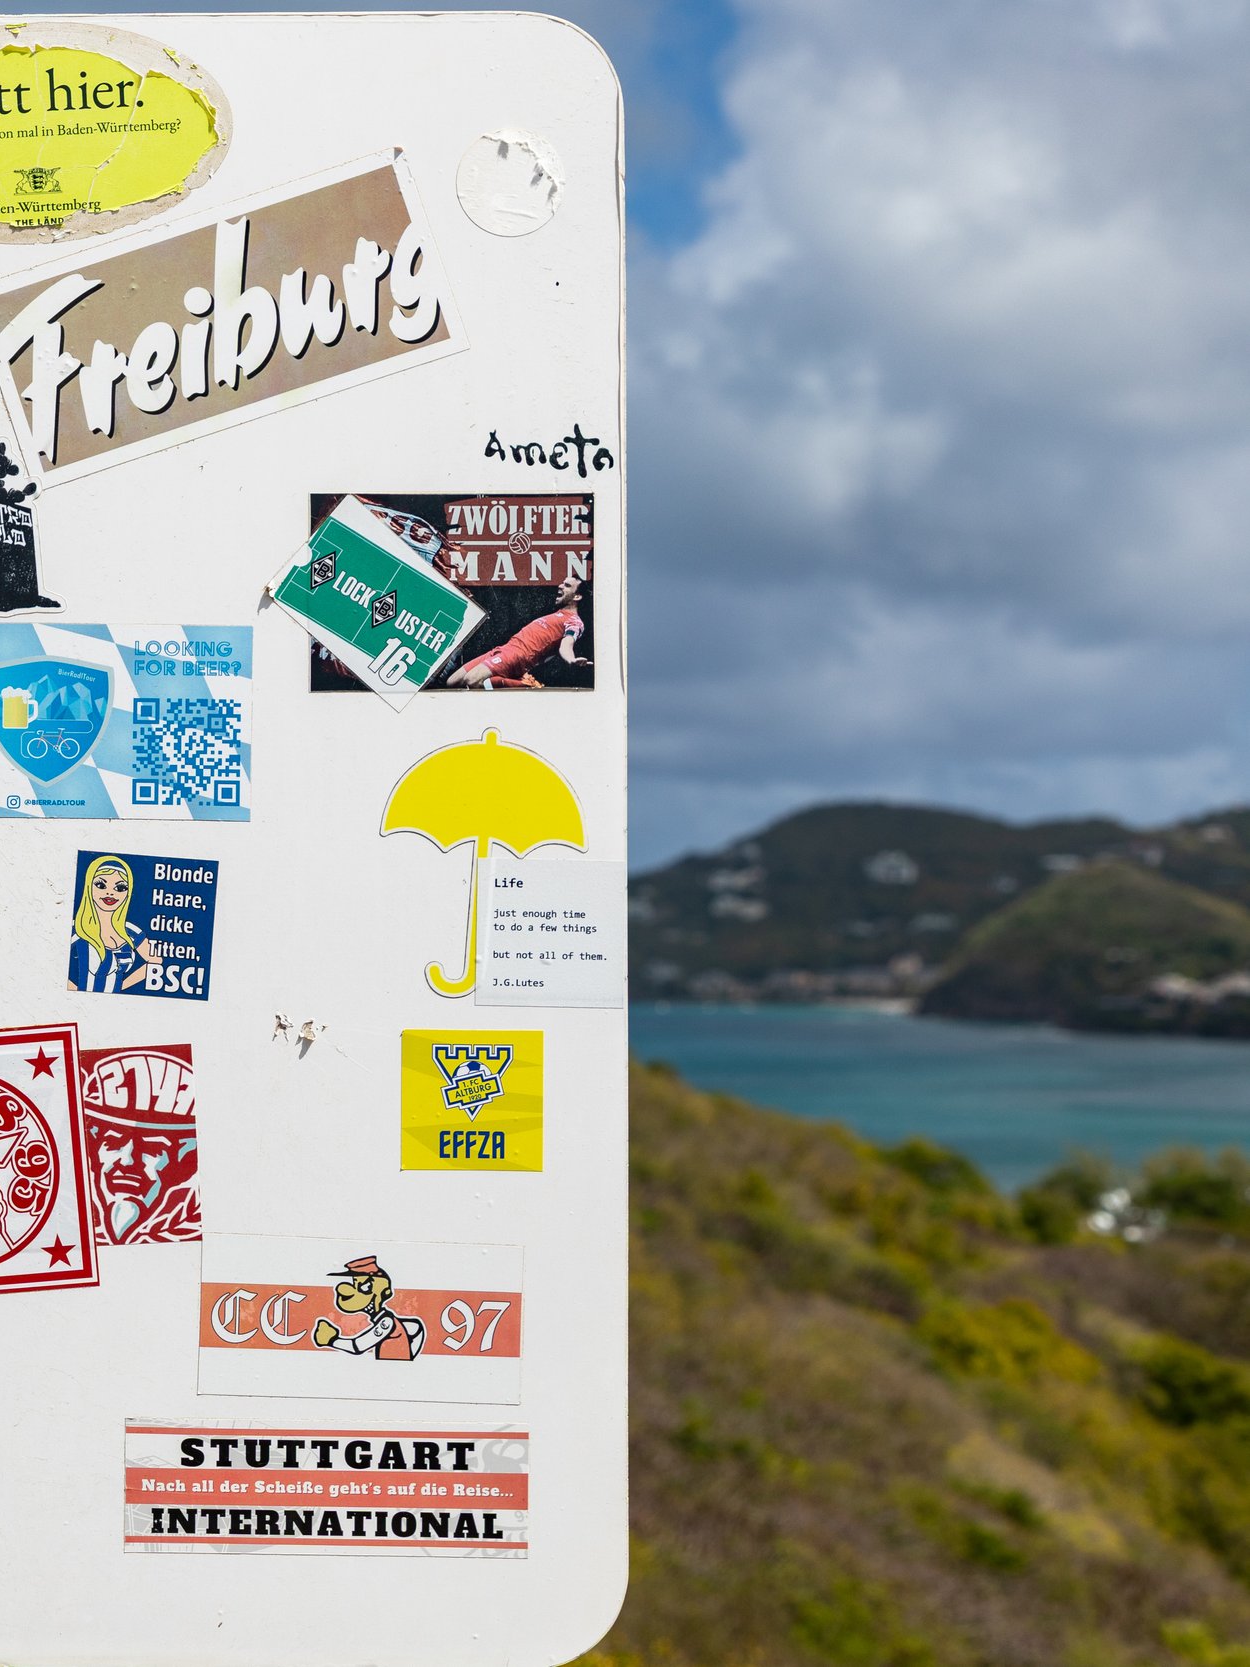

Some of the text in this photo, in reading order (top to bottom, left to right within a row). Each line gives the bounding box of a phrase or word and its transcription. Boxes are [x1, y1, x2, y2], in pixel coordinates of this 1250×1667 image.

[45, 67, 144, 112] hier.
[16, 124, 39, 138] mal
[41, 124, 54, 137] in
[57, 118, 182, 137] Baden-Württemberg?
[15, 216, 65, 227] THE LÄND
[448, 500, 590, 535] ZWÖLFTER
[449, 551, 590, 581] MANN
[134, 640, 233, 657] LOOKING
[134, 660, 242, 677] FOR BEER?
[368, 637, 418, 686] 16
[24, 798, 86, 807] @BIERRADLTOUR
[154, 863, 214, 884] Blonde
[494, 877, 524, 888] Life
[152, 889, 207, 911] Haare,
[150, 915, 194, 934] dicke
[493, 909, 586, 920] just enough time
[493, 923, 505, 931] to
[510, 923, 523, 932] do
[540, 923, 557, 932] few
[562, 924, 597, 934] things
[148, 939, 201, 961] Titten,
[493, 950, 608, 961] but not all of them.
[145, 964, 205, 995] BSC!
[492, 978, 545, 988] J.G.Lutes
[455, 1083, 492, 1098] ALTBURG
[439, 1131, 505, 1159] EFFZA
[440, 1299, 511, 1352] 97
[180, 1438, 475, 1471] STUTTGART
[141, 1479, 186, 1493] Nach
[191, 1479, 215, 1493] all
[219, 1479, 249, 1494] der
[254, 1480, 324, 1495] Scheiße
[387, 1482, 416, 1496] auf
[420, 1483, 447, 1497] die
[453, 1485, 514, 1498] Reise...
[151, 1507, 503, 1540] INTERNATIONAL
